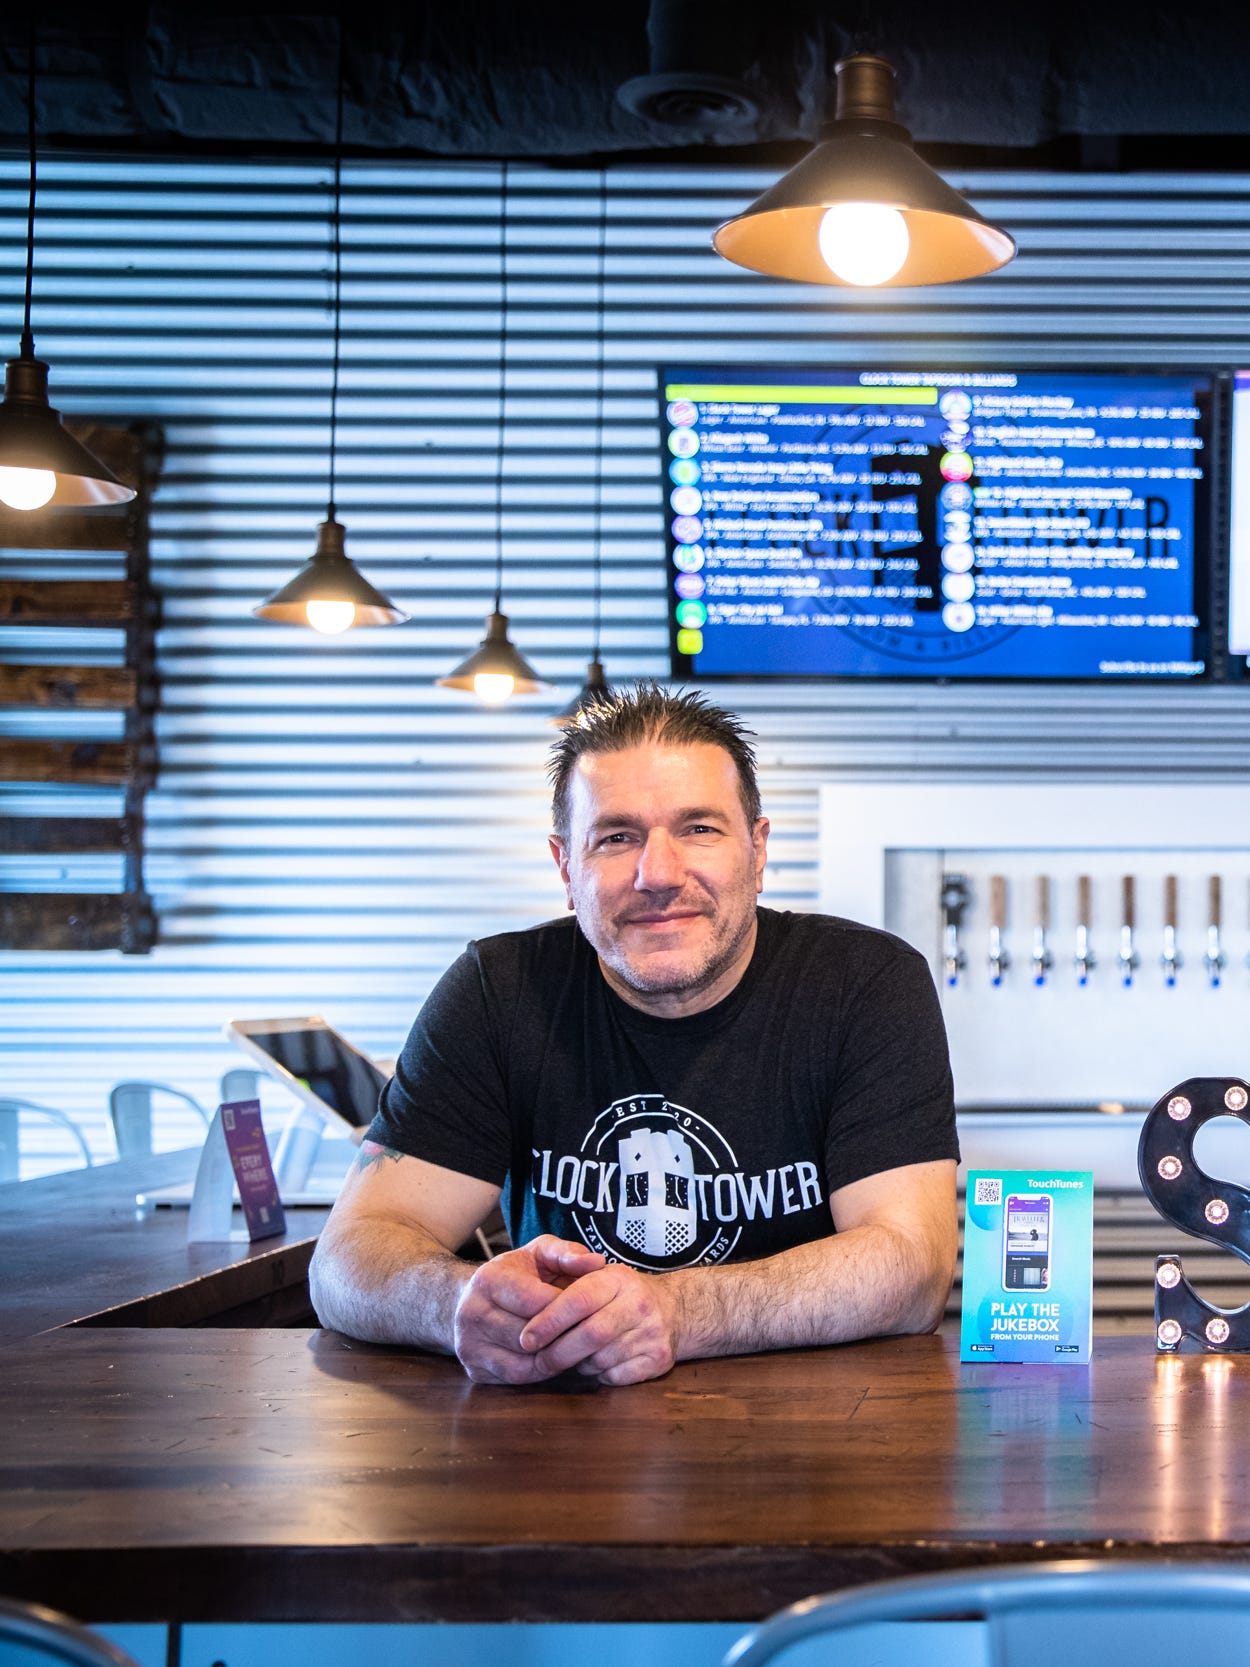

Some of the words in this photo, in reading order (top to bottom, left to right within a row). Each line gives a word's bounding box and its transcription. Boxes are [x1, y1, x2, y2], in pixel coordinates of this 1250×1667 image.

[615, 1100, 647, 1118] EST
[1027, 1178, 1084, 1190] TouchTunes
[694, 1161, 824, 1222] TOWER
[990, 1302, 1028, 1316] PLAY
[1031, 1303, 1060, 1317] THE
[990, 1318, 1060, 1332] JUKEBOX
[990, 1333, 1012, 1341] FROM
[1013, 1333, 1033, 1341] YOUR
[1034, 1333, 1060, 1341] PHONE
